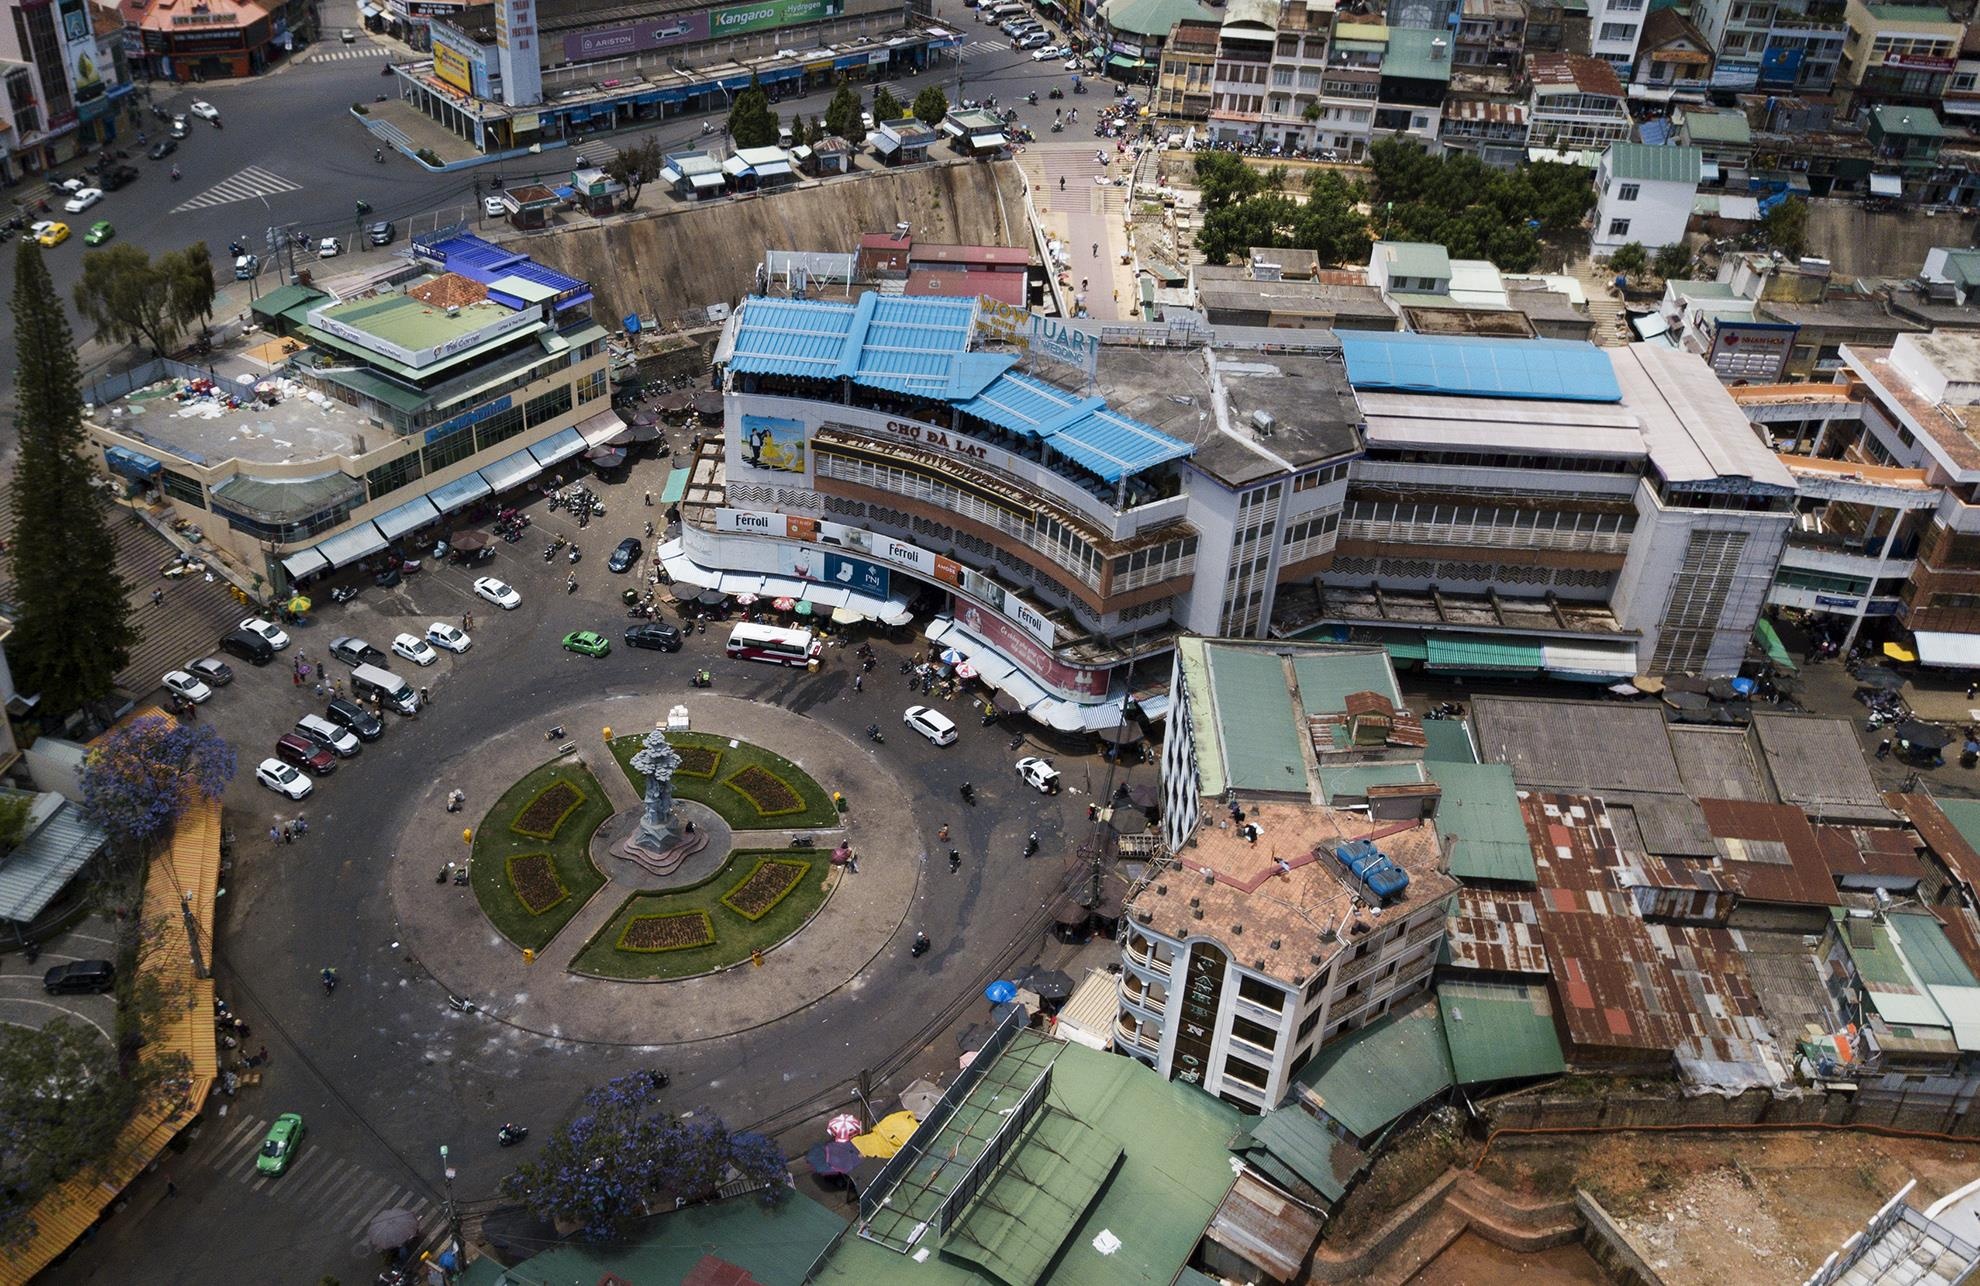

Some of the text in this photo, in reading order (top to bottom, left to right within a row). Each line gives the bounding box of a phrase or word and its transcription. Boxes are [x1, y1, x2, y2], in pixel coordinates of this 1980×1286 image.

[716, 8, 774, 25] Kangaroo
[788, 1, 821, 14] Hydrogen
[595, 36, 631, 47] ARISTON
[979, 293, 1030, 325] WOW
[458, 334, 481, 347] Corner
[1031, 314, 1098, 354] TUART
[1042, 340, 1083, 363] WEDDING
[886, 421, 987, 459] CHỢ ĐÀ LẠT
[736, 514, 768, 527] Ferroli
[889, 543, 919, 562] Ferroli
[865, 575, 880, 586] PNJ
[1018, 607, 1042, 631] Ferroli
